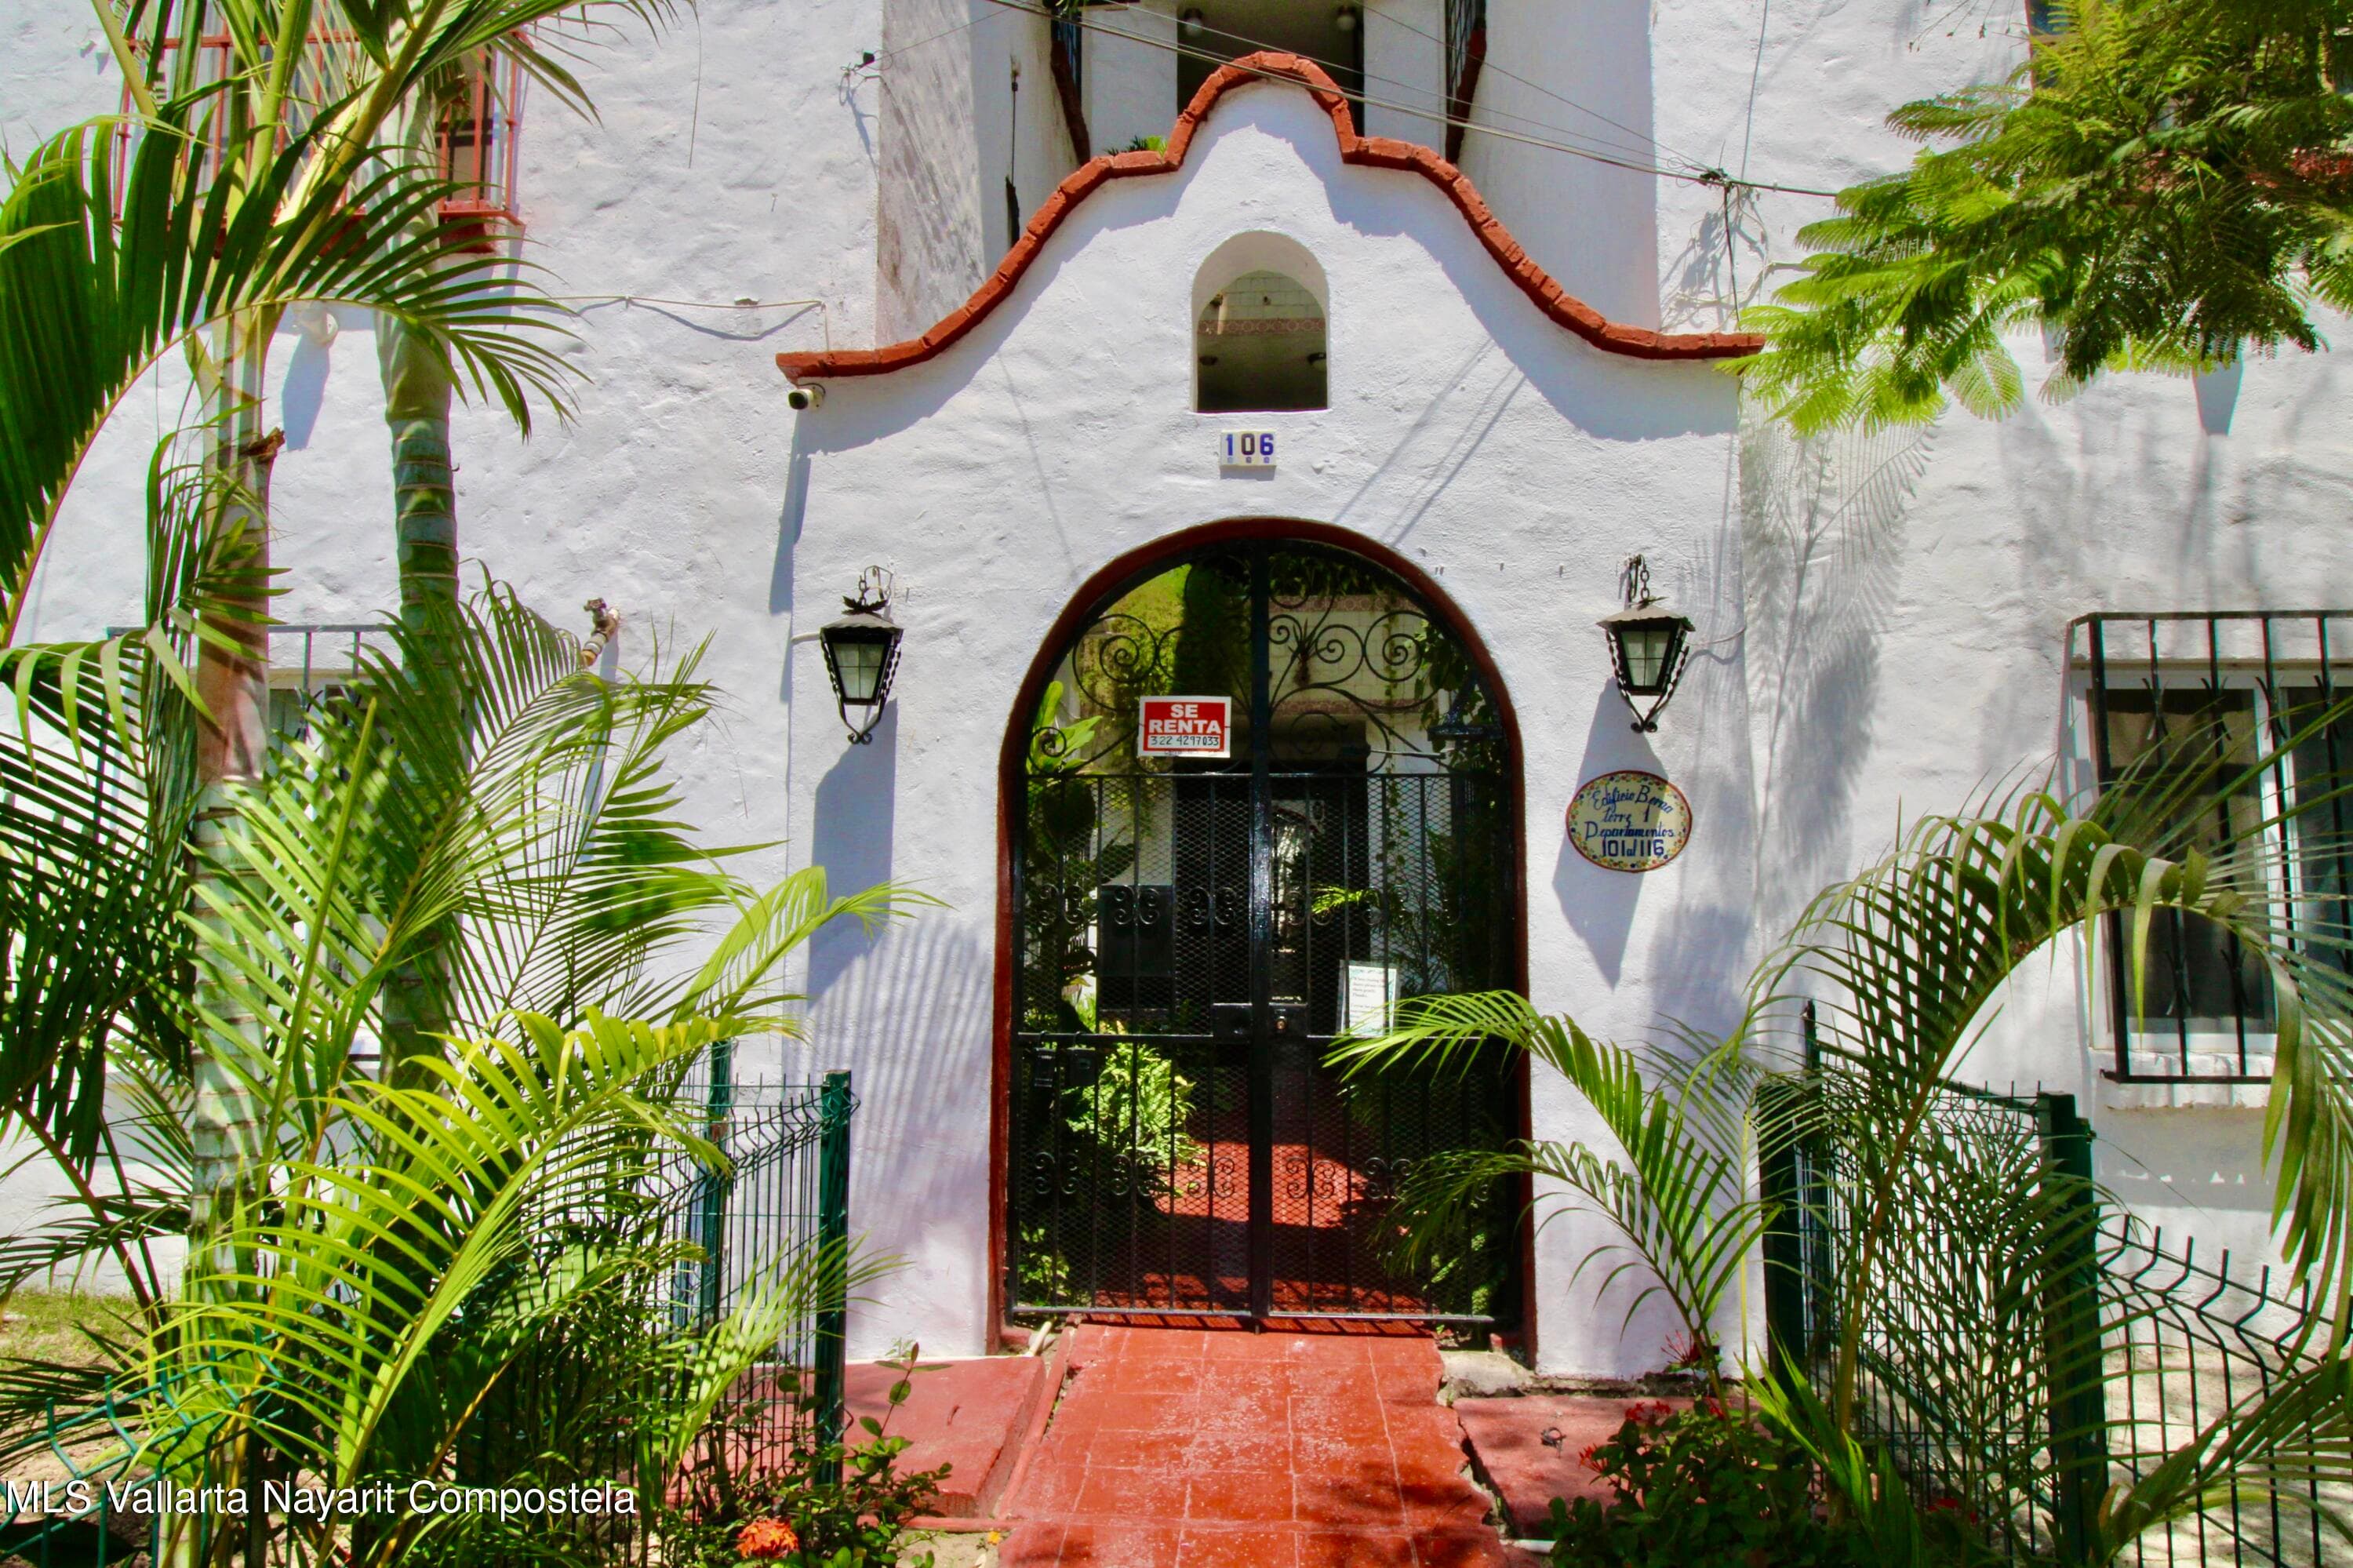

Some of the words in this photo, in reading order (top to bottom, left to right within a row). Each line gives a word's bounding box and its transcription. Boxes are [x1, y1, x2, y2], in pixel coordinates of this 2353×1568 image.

[1225, 433, 1274, 456] 106
[1170, 704, 1198, 718] SE
[1149, 719, 1221, 733] RENTA
[1150, 736, 1173, 745] 322
[1584, 820, 1675, 841] Departamentos
[1640, 839, 1664, 857] 116
